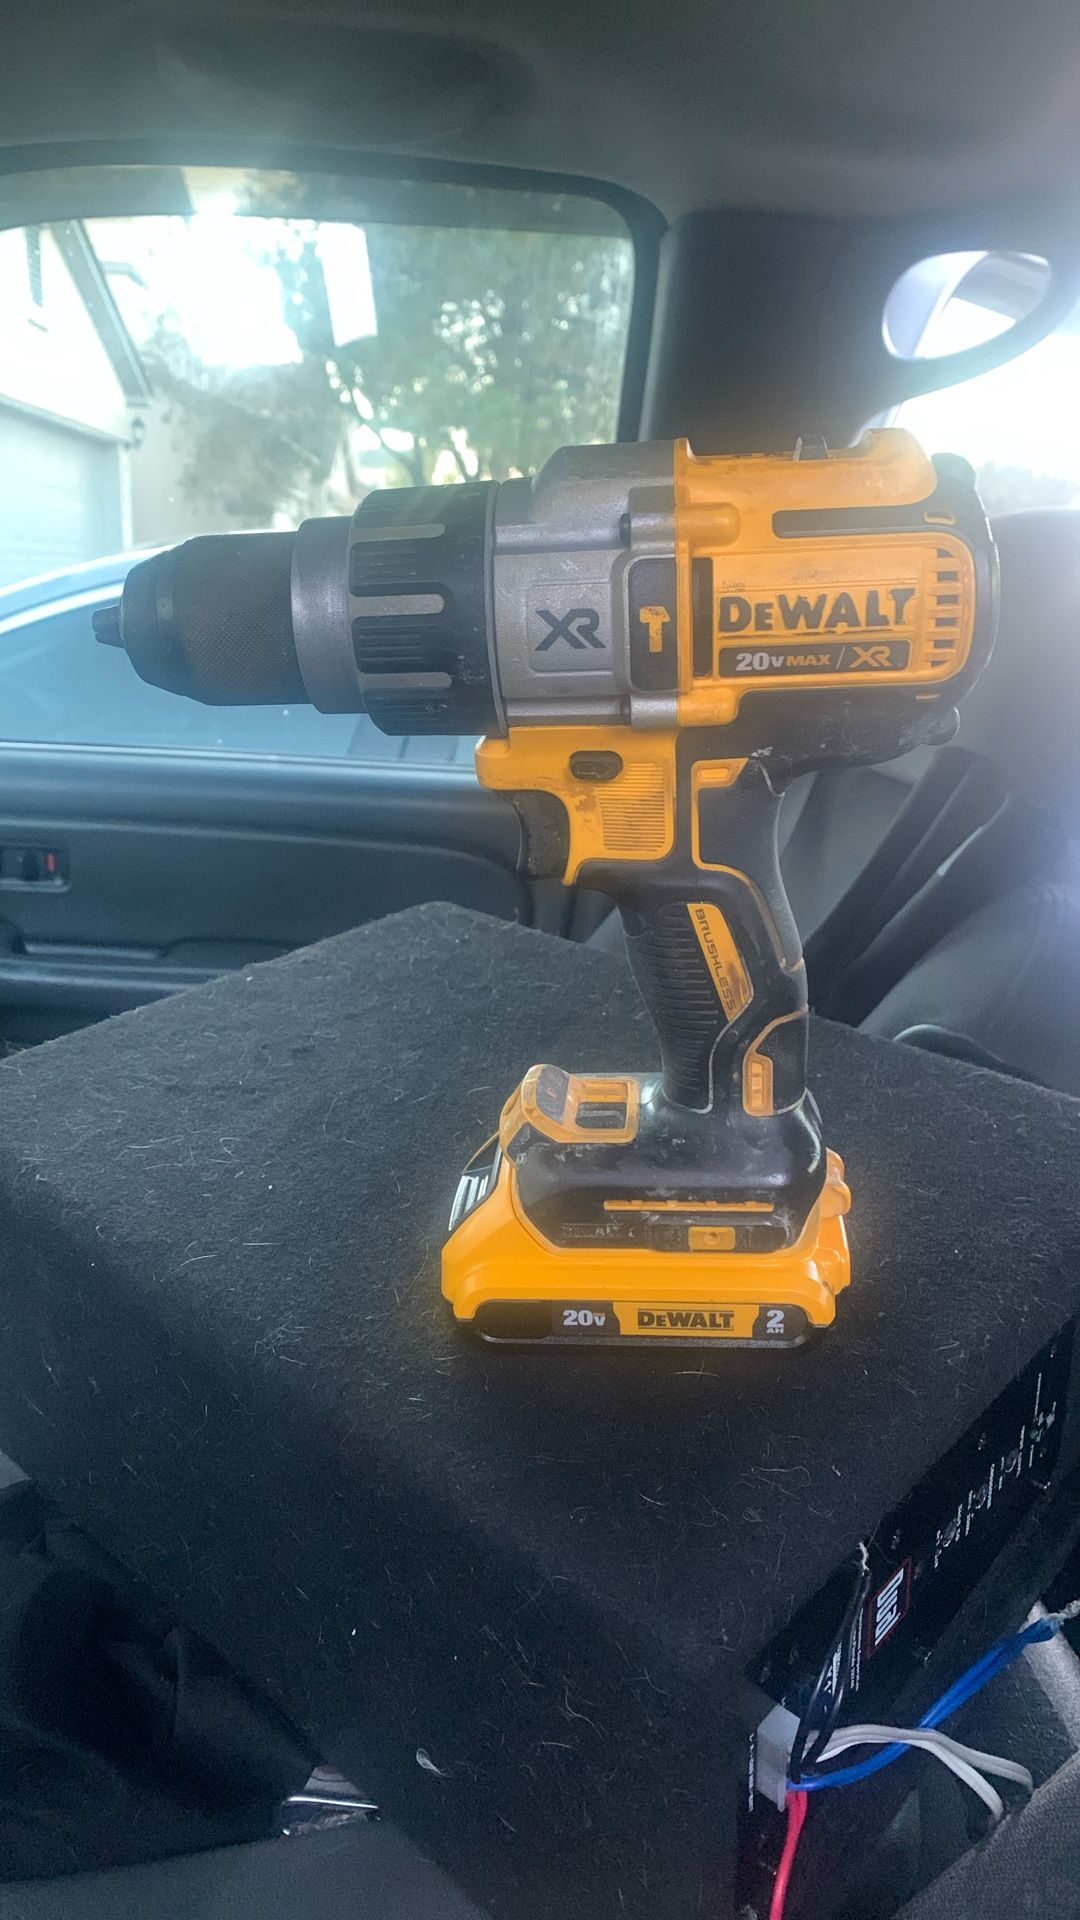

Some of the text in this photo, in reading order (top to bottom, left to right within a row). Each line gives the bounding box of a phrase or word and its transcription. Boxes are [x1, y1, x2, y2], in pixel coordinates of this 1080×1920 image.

[534, 609, 607, 652] XR
[848, 645, 893, 668] XR
[695, 908, 736, 1011] BRUSHLESS
[766, 1309, 785, 1328] 2
